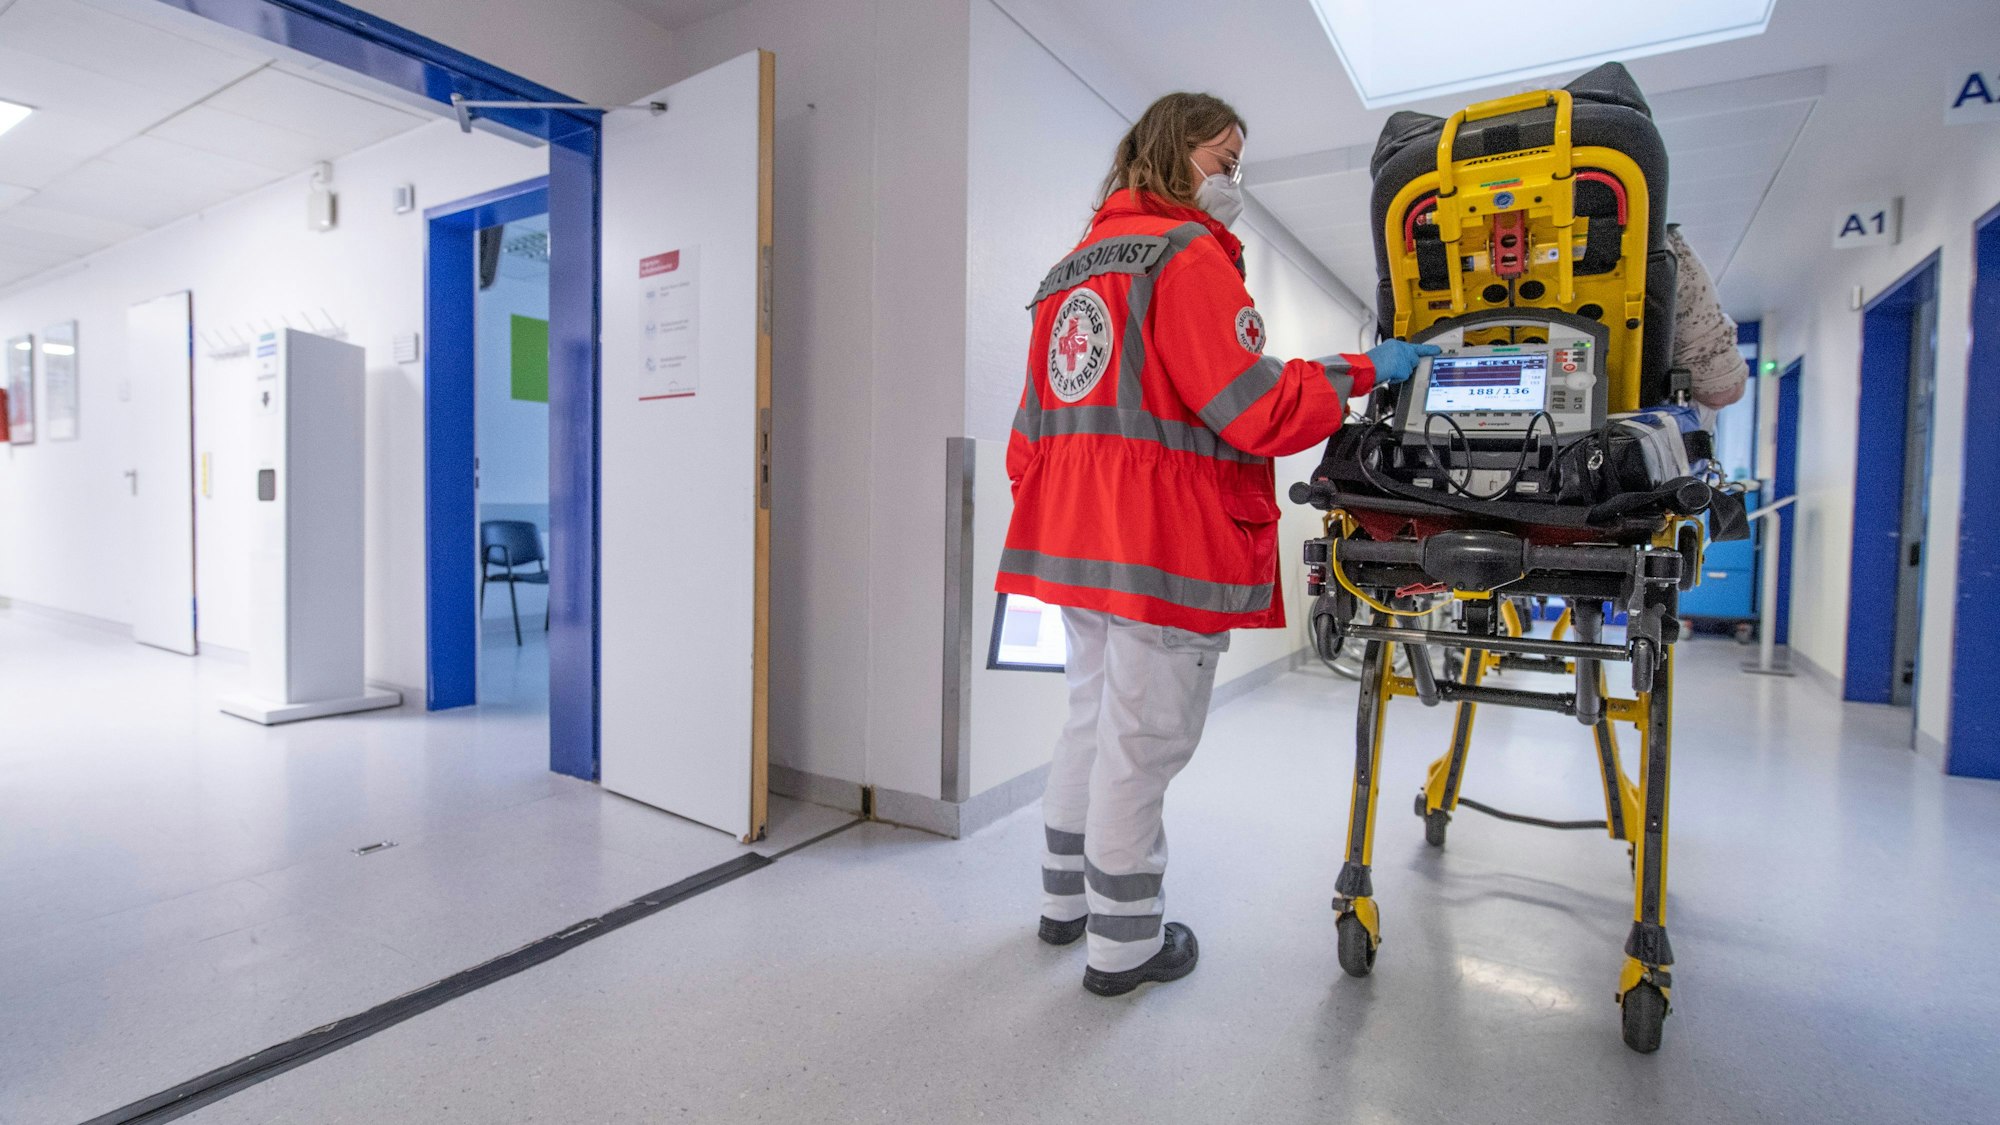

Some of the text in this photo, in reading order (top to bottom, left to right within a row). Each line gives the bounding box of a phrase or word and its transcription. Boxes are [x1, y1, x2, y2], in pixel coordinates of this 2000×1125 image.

[1952, 72, 2000, 109] A
[1839, 211, 1886, 238] A1
[1038, 243, 1157, 293] ETTUNGSDIENST
[1053, 299, 1103, 338] DEUTSCHES
[1069, 345, 1103, 391] KREUZ
[1468, 387, 1530, 396] 188/136
